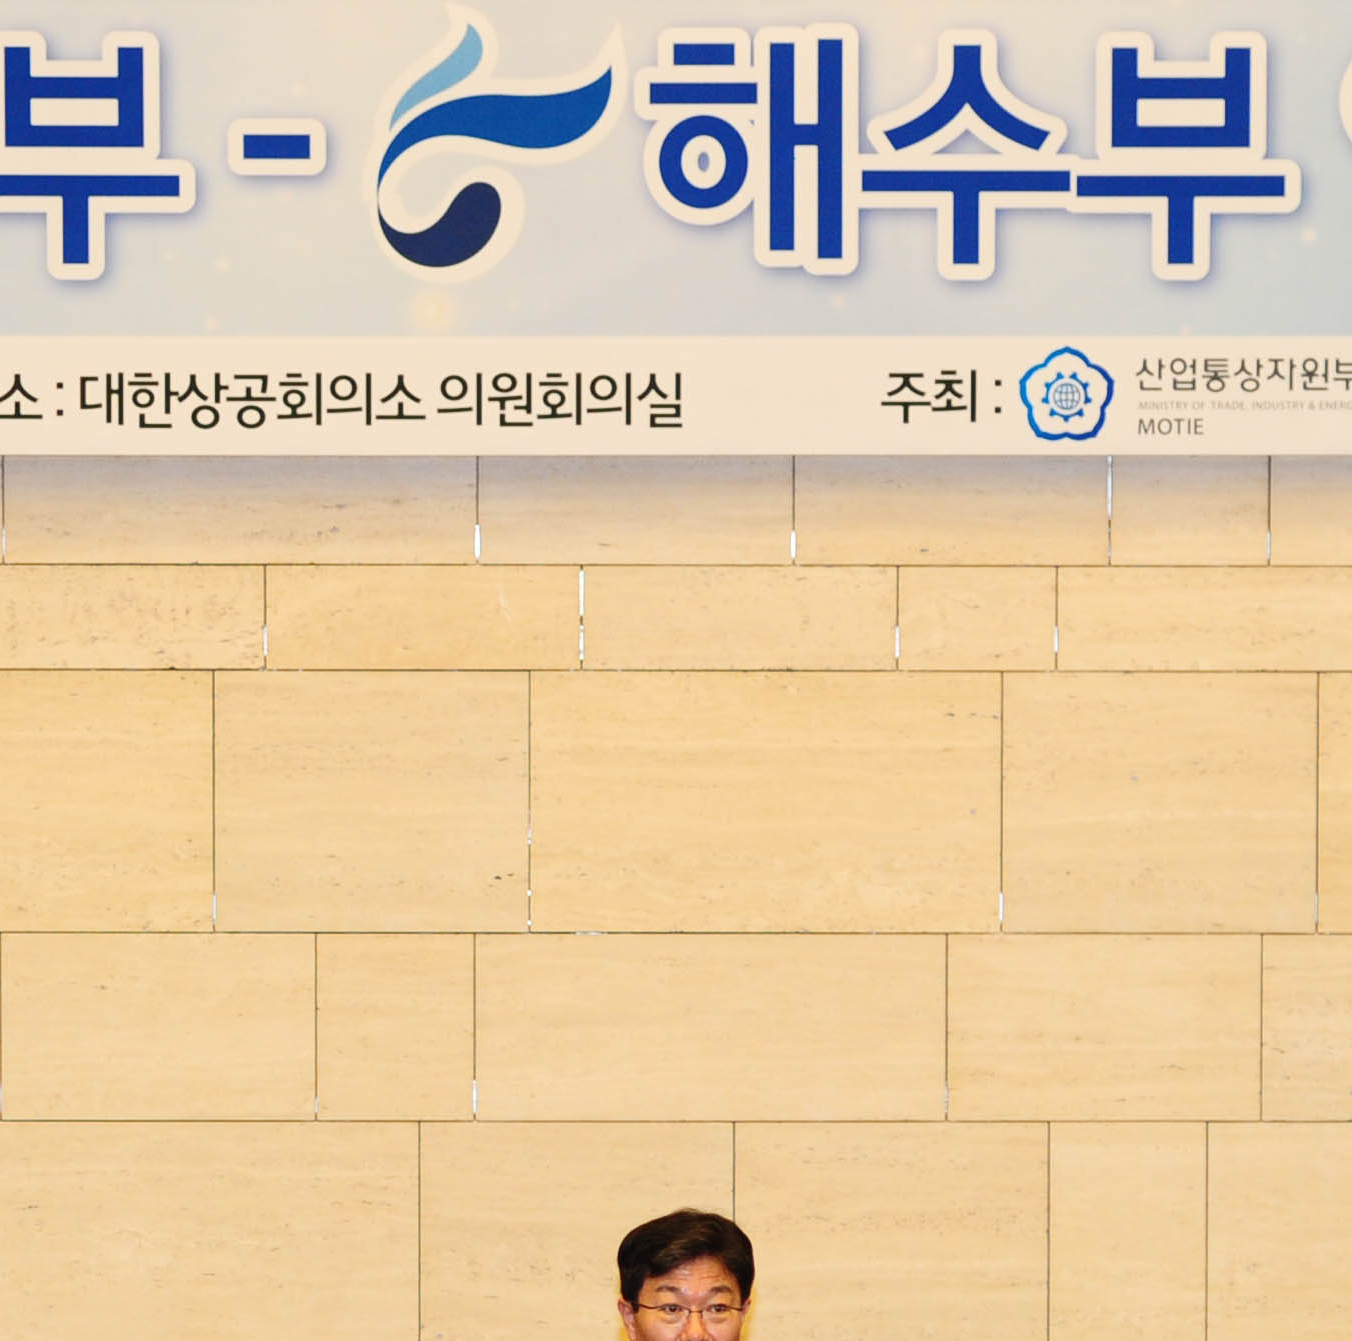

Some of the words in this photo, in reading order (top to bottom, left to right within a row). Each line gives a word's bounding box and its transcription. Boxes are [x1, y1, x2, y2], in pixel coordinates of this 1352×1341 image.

[648, 36, 1286, 266] 해수부
[78, 371, 427, 431] 대한상공회의소
[435, 371, 684, 429] 의원회의실
[1137, 399, 1189, 411] MINISTRY
[1191, 399, 1206, 411] OF
[1252, 399, 1305, 411] INDUSTRY
[1137, 417, 1204, 436] MOTIE
